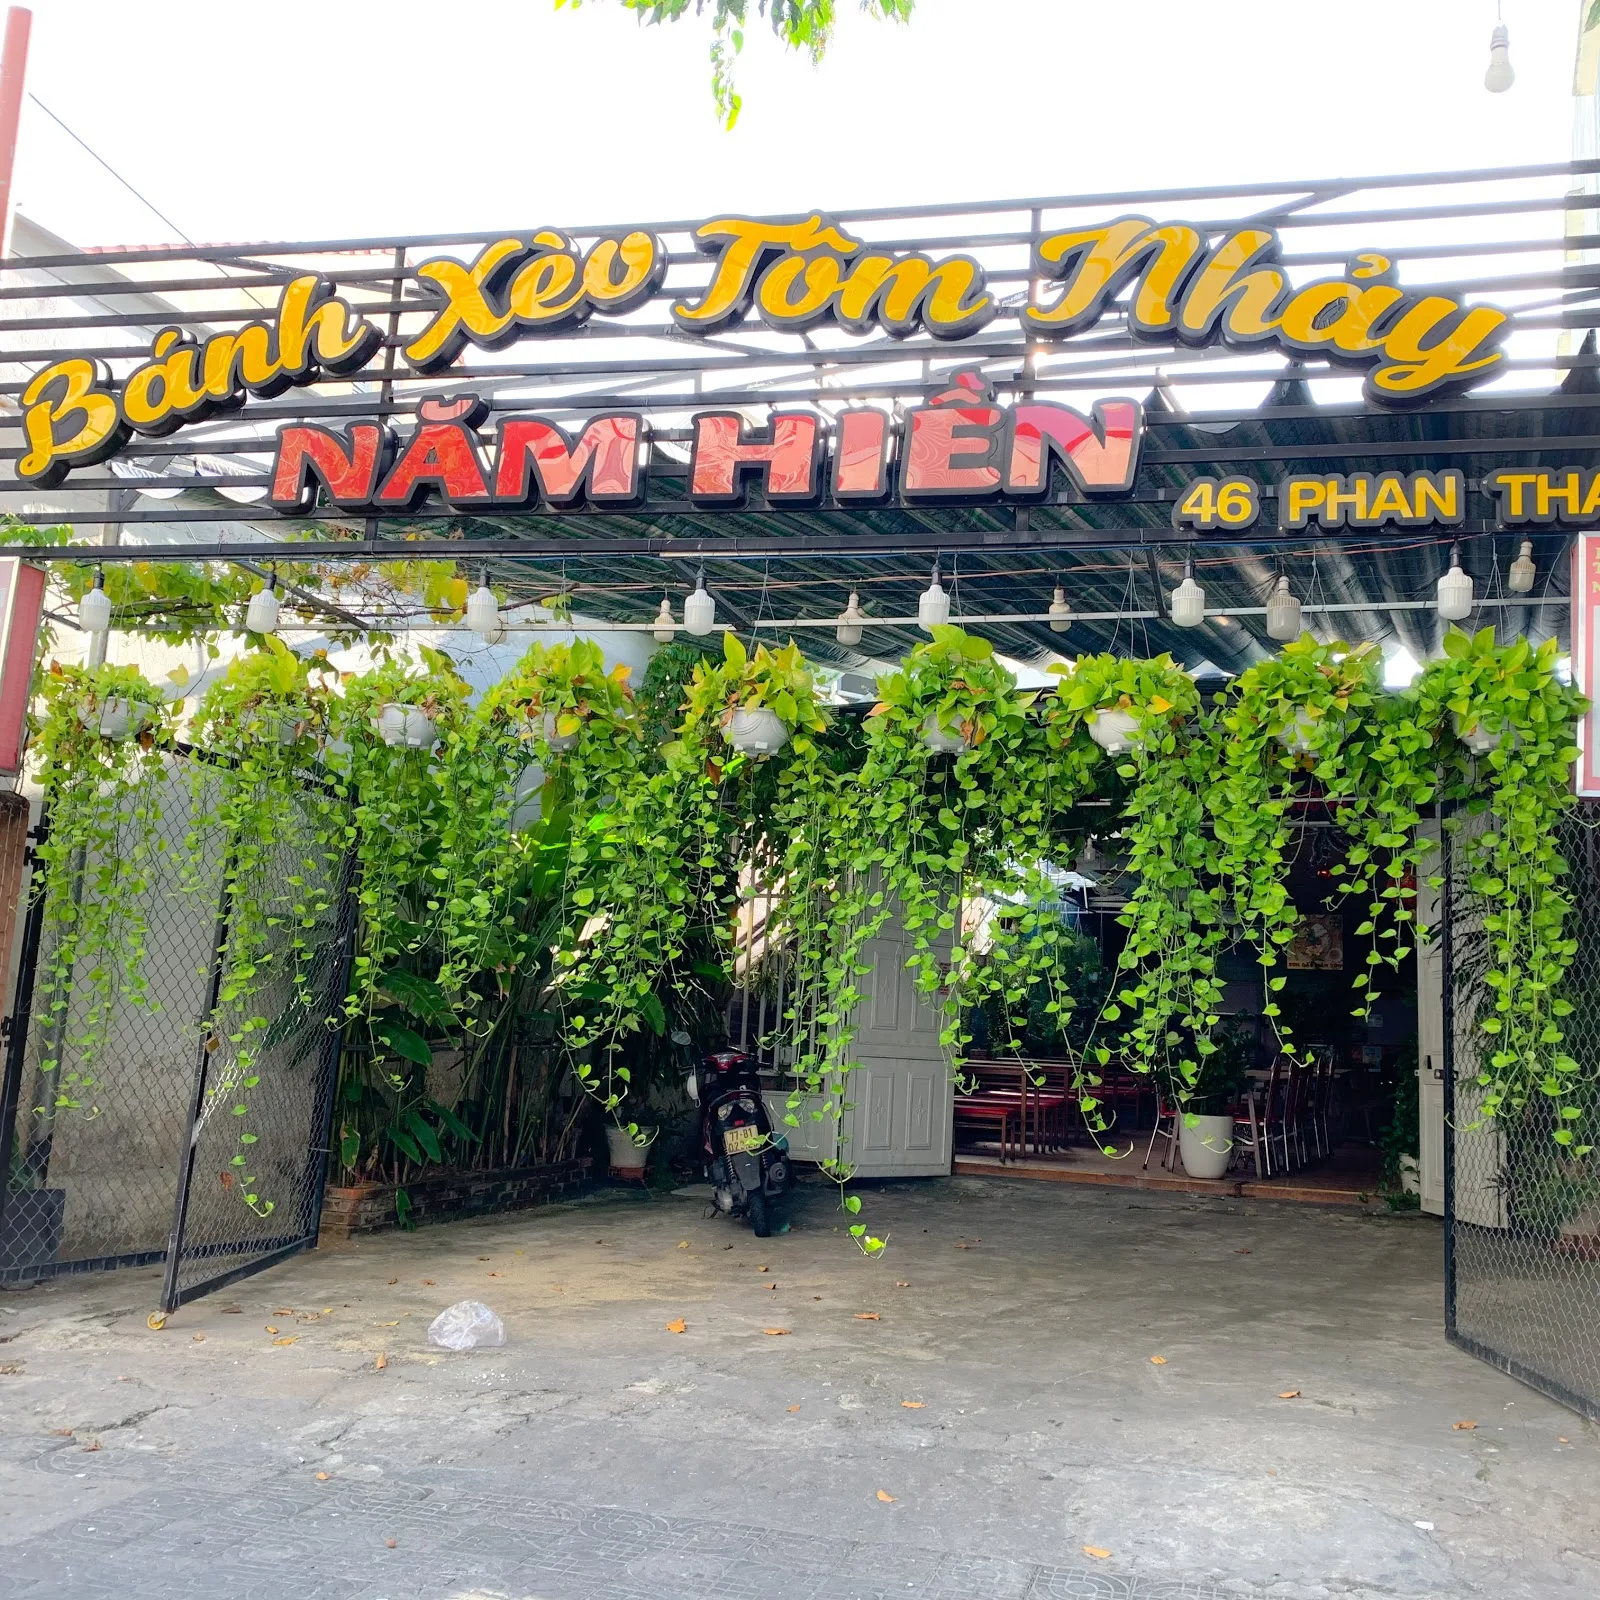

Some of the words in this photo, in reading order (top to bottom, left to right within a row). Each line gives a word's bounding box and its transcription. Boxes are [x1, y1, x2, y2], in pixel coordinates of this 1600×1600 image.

[17, 275, 366, 477] Bánh
[405, 231, 654, 361] Xèo
[675, 214, 989, 325] Tôm
[1025, 219, 1508, 392] Nhảy
[271, 399, 637, 500] NĂM
[692, 371, 1136, 495] HIỀN
[1181, 481, 1252, 523] 46
[1289, 476, 1457, 522] PHAN
